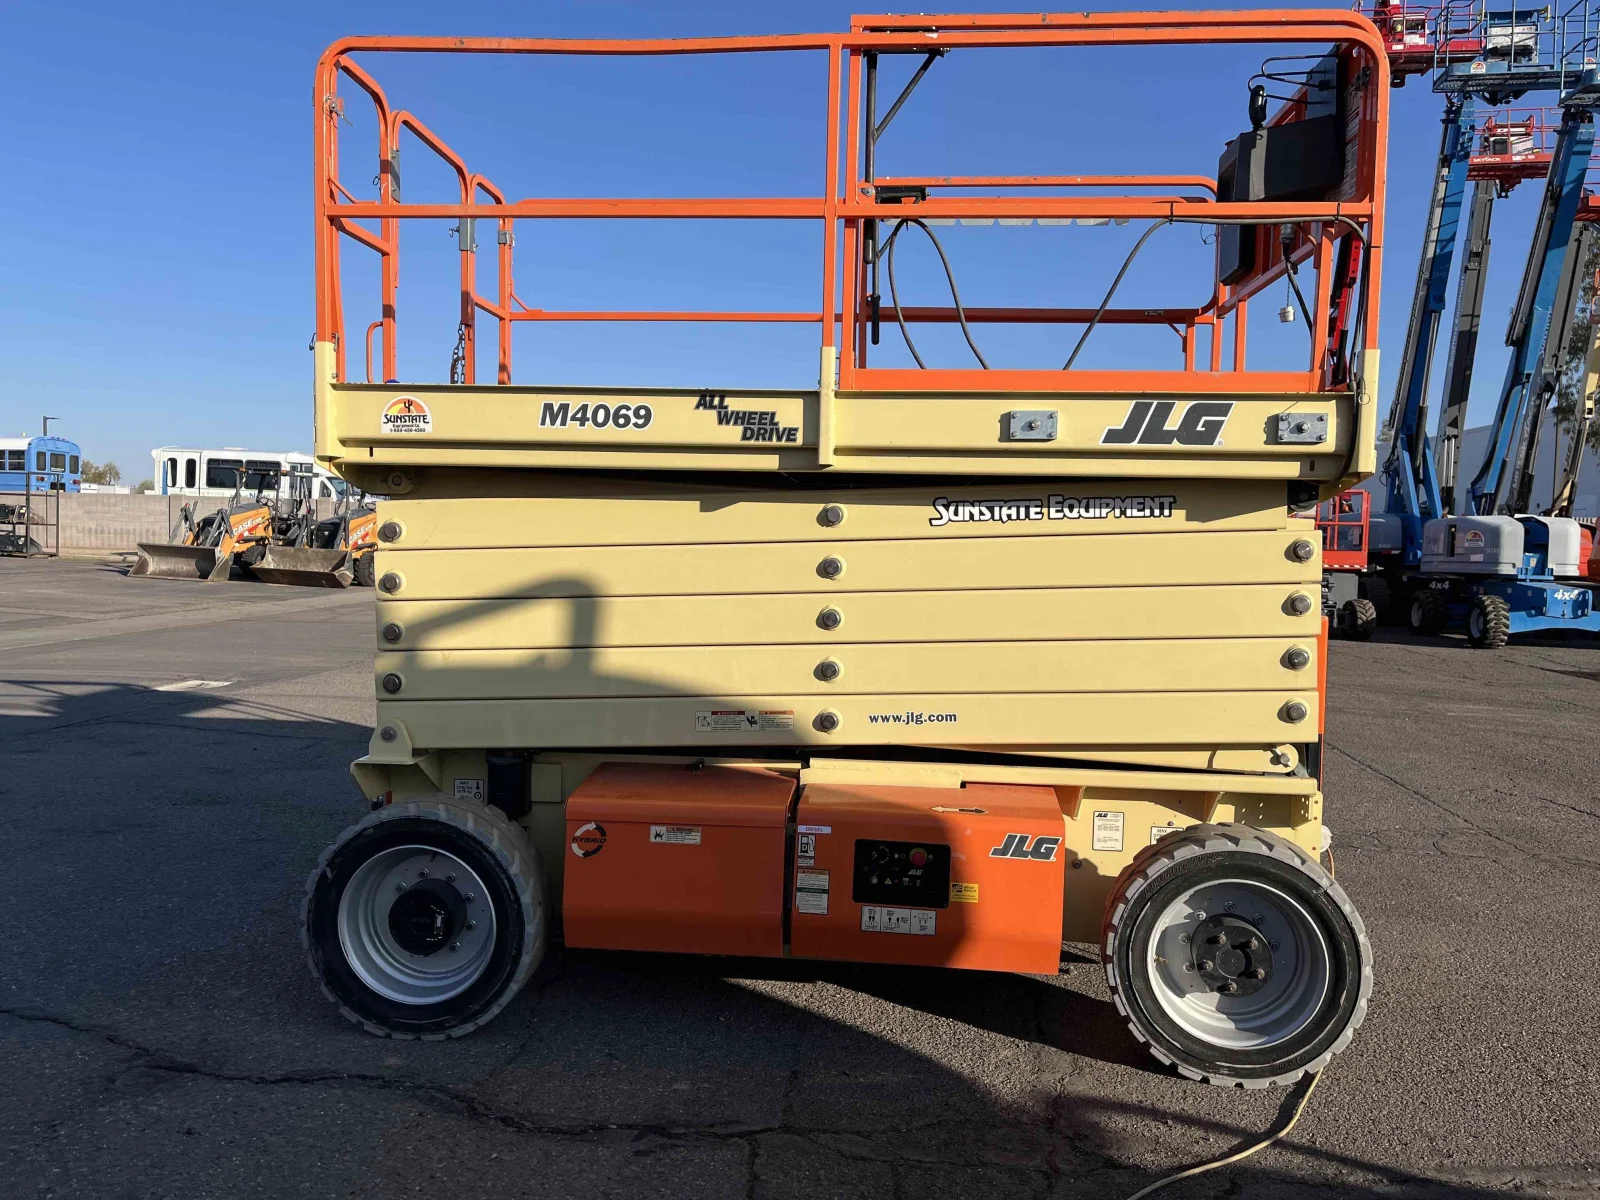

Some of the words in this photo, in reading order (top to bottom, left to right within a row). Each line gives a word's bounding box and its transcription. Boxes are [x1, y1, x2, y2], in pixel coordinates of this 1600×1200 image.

[694, 393, 728, 411] ALL
[383, 414, 430, 424] SUNSTATE
[538, 401, 653, 430] M4069
[716, 410, 779, 427] WHEEL
[1099, 400, 1237, 447] JLG
[740, 426, 799, 442] DRIVE
[929, 497, 1045, 527] SUNSTATE
[1047, 493, 1177, 520] EQUIPMENT
[233, 519, 253, 536] CASE
[1429, 581, 1450, 590] 4x4
[1553, 589, 1580, 601] 4x4
[868, 712, 957, 725] www.jlg.com
[571, 836, 607, 844] HYBRID
[988, 832, 1063, 861] JLG
